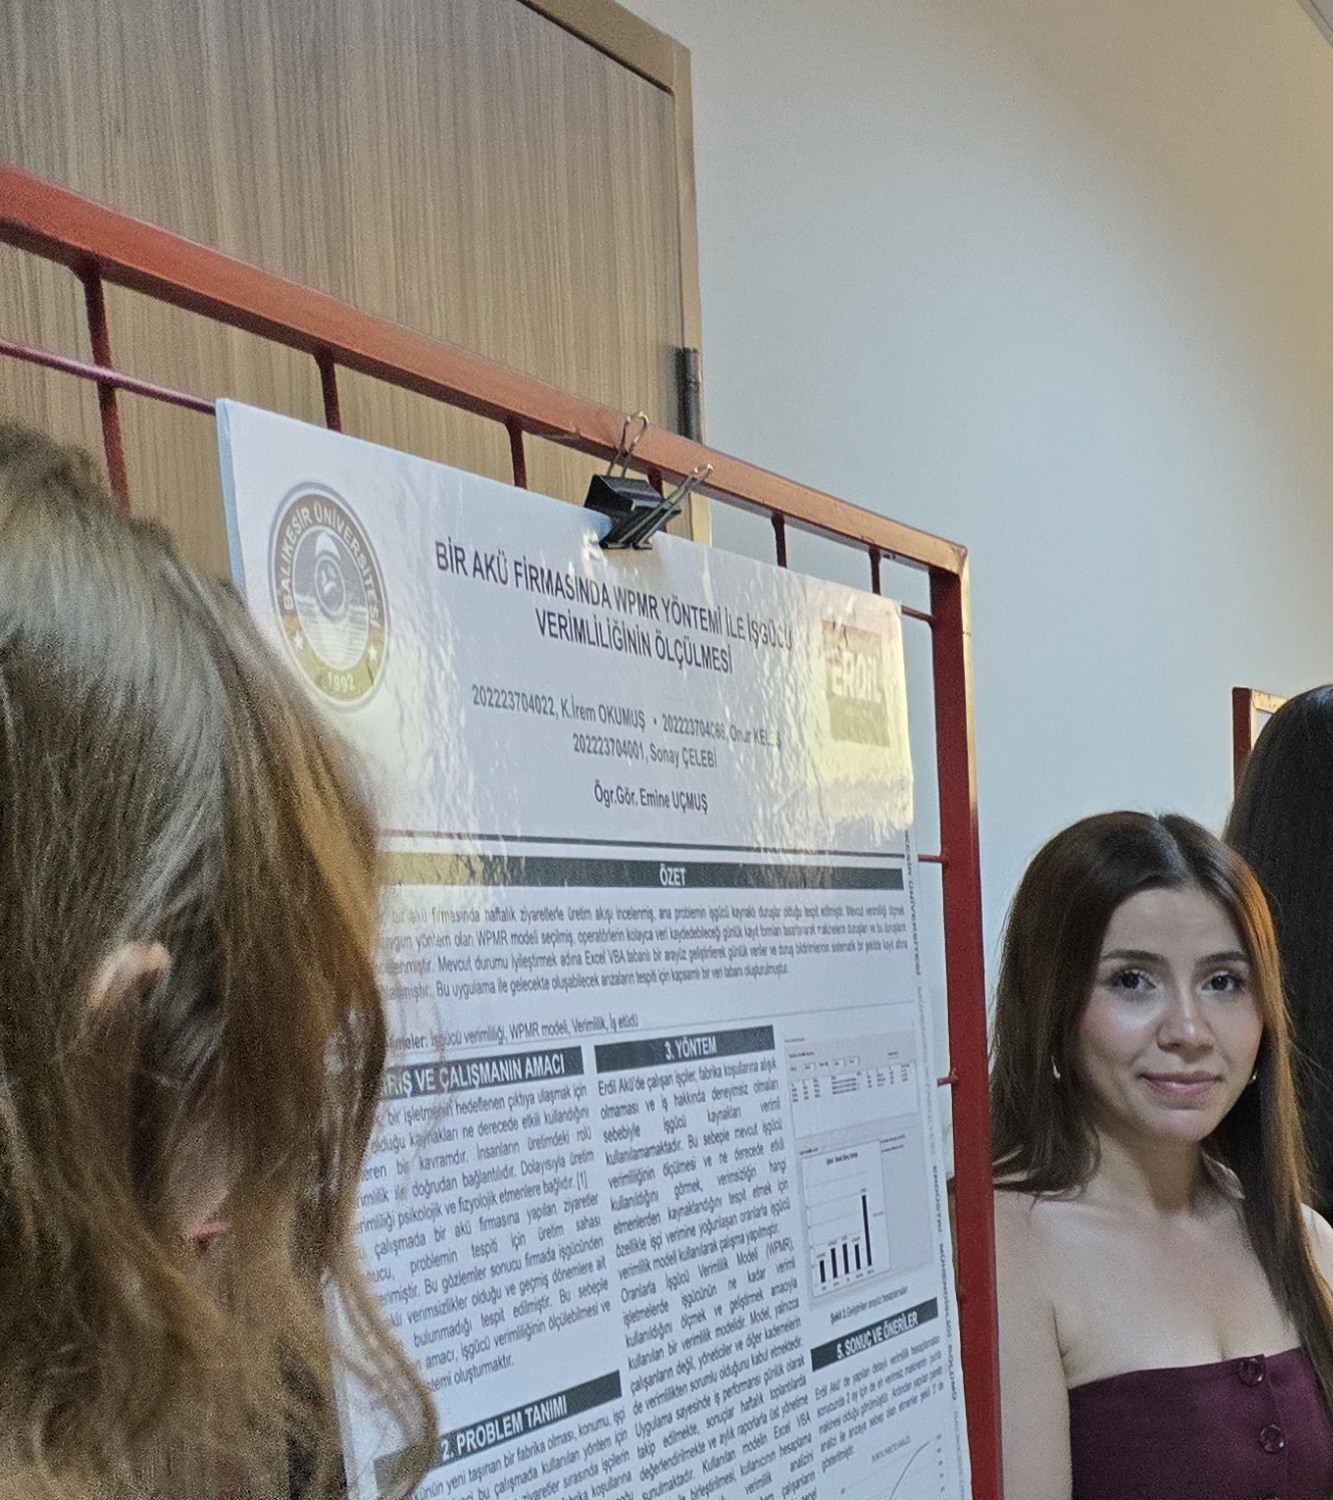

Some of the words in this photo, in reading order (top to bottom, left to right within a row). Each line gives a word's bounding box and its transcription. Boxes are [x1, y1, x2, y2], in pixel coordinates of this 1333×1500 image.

[283, 506, 313, 609] BALIKESİR
[314, 503, 381, 627] ÜNİVERSİTESİ
[433, 533, 468, 576] BİR
[469, 542, 509, 586] AKÜ
[512, 552, 612, 613] FİRMASINDA
[613, 585, 660, 623] WPMR
[660, 592, 722, 635] YÖNTEMİ
[724, 607, 745, 641] İLE
[535, 606, 651, 658] VERİMLİLİĞİNİN
[653, 630, 733, 679] ÖLÇÜLMESİ
[327, 671, 356, 692] 1992
[471, 684, 558, 720] 202223704022,
[597, 703, 646, 733] OKUMUŞ
[572, 733, 648, 766] 202223704001,
[649, 742, 680, 769] Sonay
[681, 743, 717, 772] ÇELEBİ
[752, 724, 785, 753] KELŞ
[639, 788, 670, 809] Emine
[671, 790, 708, 815] UÇMUŞ
[658, 863, 687, 886] ÖZET
[415, 1069, 437, 1092] VE
[438, 1059, 524, 1093] ÇALIŞMANIN
[523, 1053, 566, 1077] AMACI
[664, 1040, 674, 1060] 3.
[674, 1034, 717, 1059] YÖNTEM
[374, 1229, 427, 1260] çalışmada
[433, 1224, 447, 1243] bir
[453, 1219, 472, 1238] akü
[478, 1207, 520, 1233] firmasına
[526, 1200, 557, 1224] yapılan
[563, 1190, 599, 1215] ziyaretler
[397, 1200, 443, 1230] psikolojik
[444, 1201, 457, 1216] ve
[457, 1189, 498, 1216] fizyolojik
[498, 1180, 541, 1204] etmenlere
[542, 1173, 575, 1197] bağlıdır.
[576, 1169, 588, 1190] [1]
[409, 1246, 459, 1276] problemin
[470, 1236, 498, 1262] tespiti
[510, 1229, 526, 1252] için
[537, 1221, 564, 1242] üretim
[575, 1212, 601, 1232] sahası
[423, 1275, 438, 1295] Bu
[441, 1263, 487, 1294] gözlemler
[490, 1257, 522, 1278] sonucu
[524, 1245, 556, 1269] firmada
[558, 1233, 604, 1262] işgücünden
[413, 1316, 473, 1353] bulunmadığı
[480, 1306, 505, 1331] tespit
[512, 1292, 553, 1322] edilmiştir.
[558, 1286, 571, 1305] Bu
[577, 1275, 609, 1302] sebeple
[836, 1341, 845, 1361] 5.
[844, 1329, 871, 1358] SONUÇ
[872, 1325, 883, 1346] VE
[882, 1307, 919, 1341] ÖNERİLER
[440, 1437, 454, 1462] 2.
[456, 1411, 523, 1456] PROBLEM
[525, 1394, 567, 1429] TANIMI
